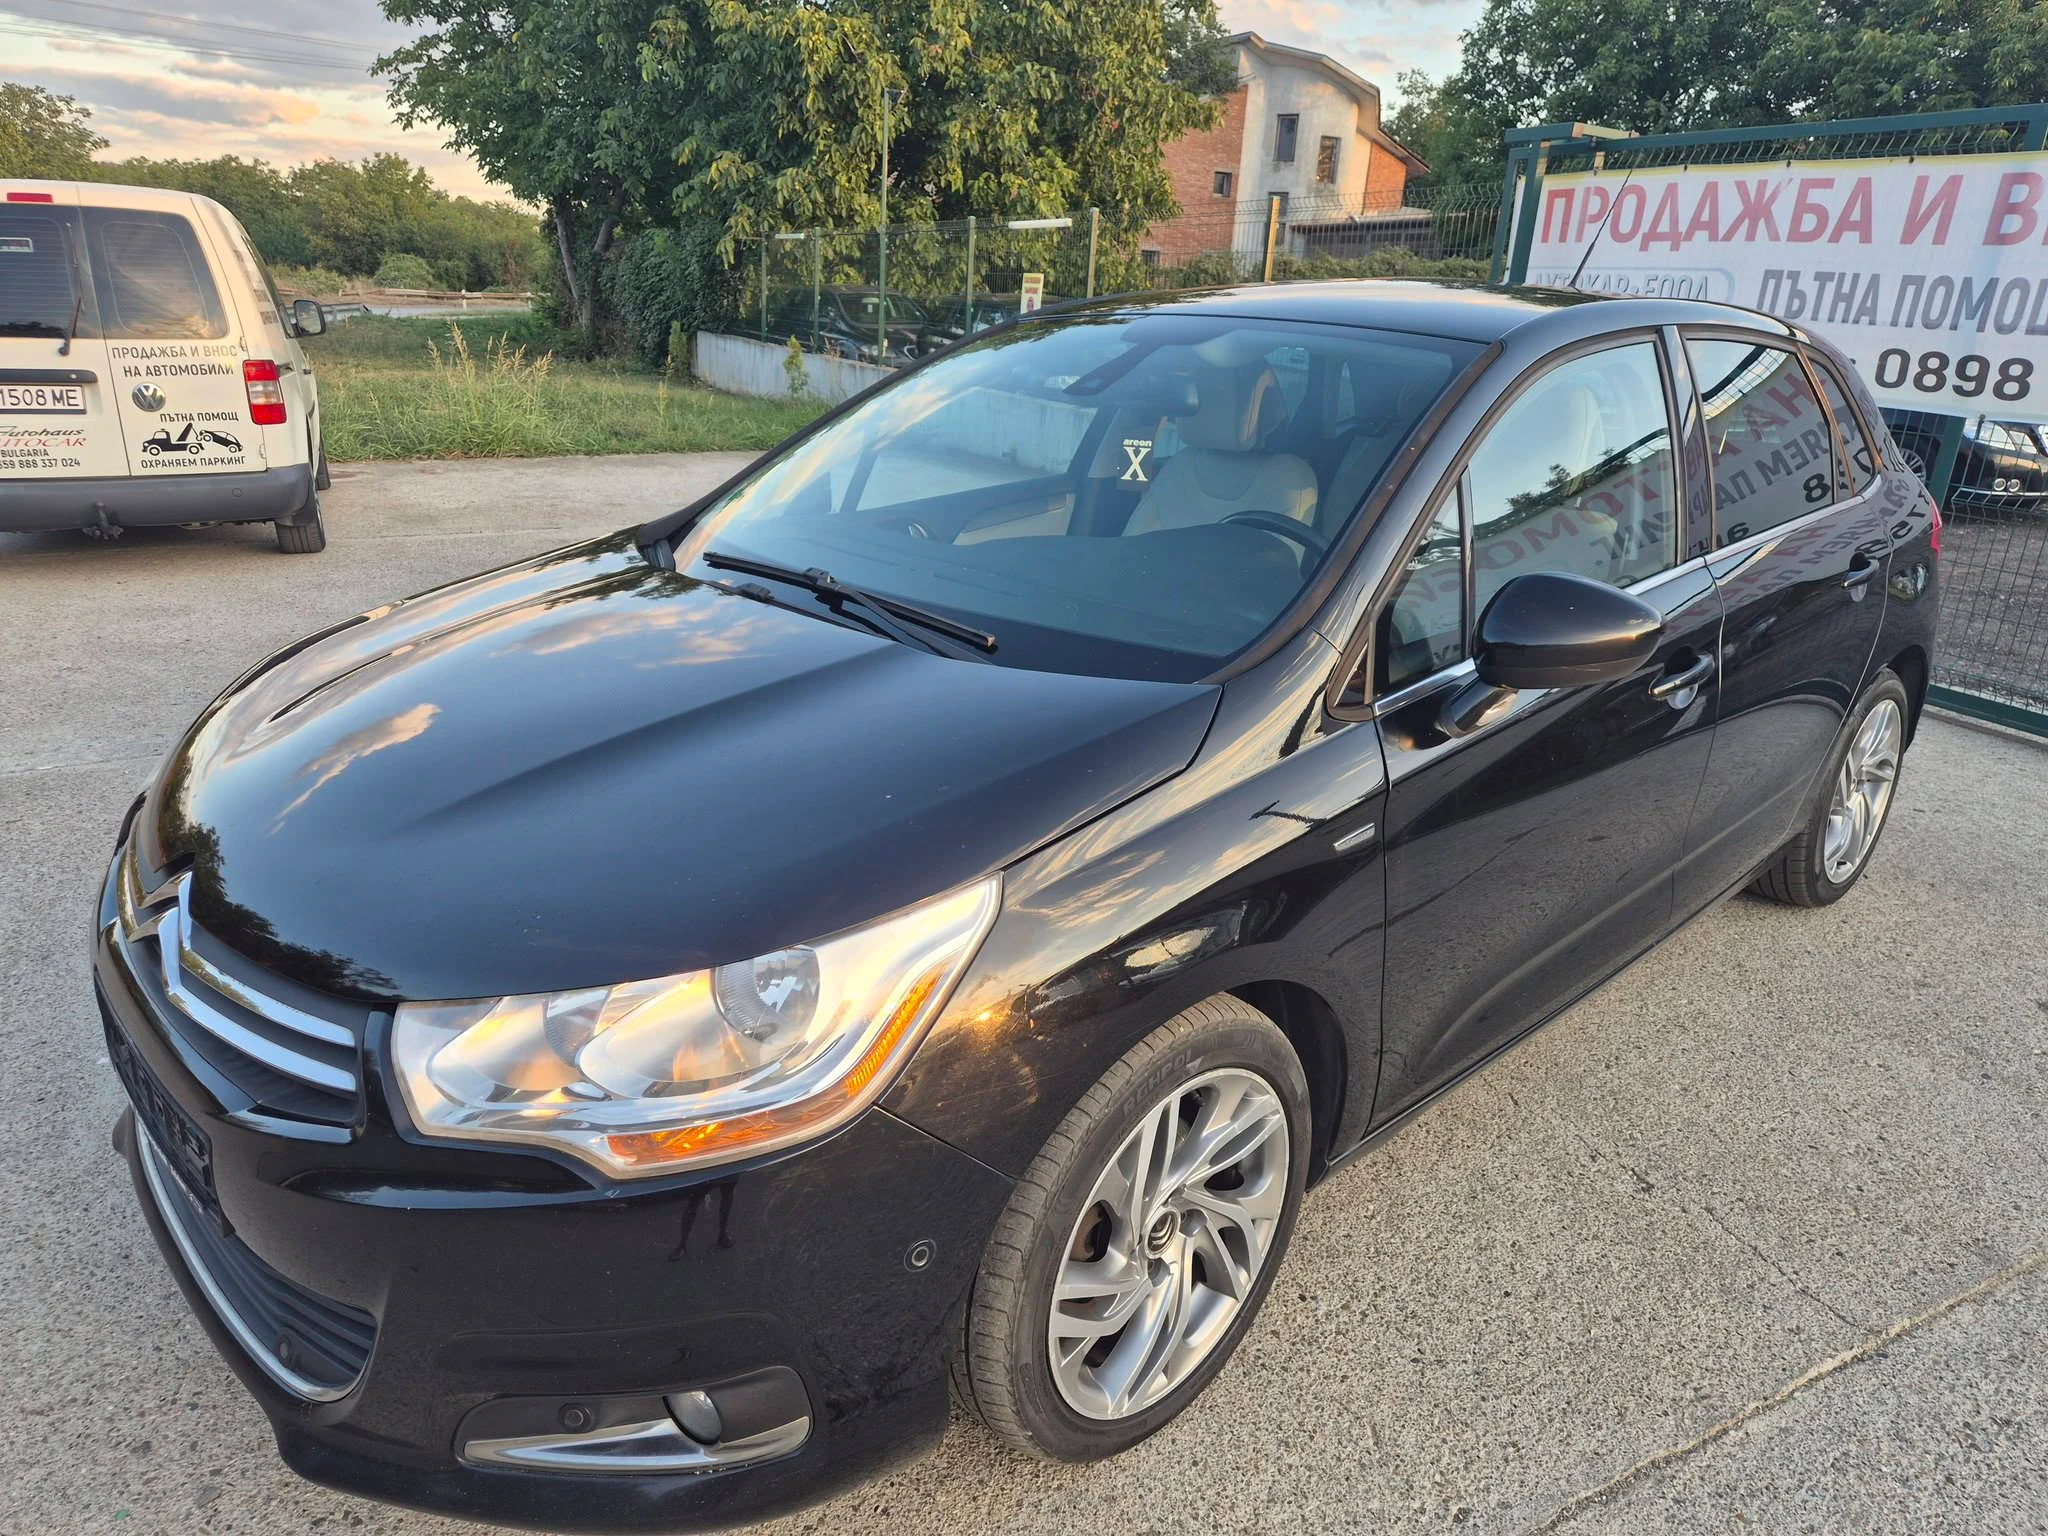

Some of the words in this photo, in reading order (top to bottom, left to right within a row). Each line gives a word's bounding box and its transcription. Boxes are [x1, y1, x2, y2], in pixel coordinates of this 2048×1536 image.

[1540, 176, 1873, 252] ПРОДАЖБА
[1900, 174, 1965, 246] И
[1982, 171, 2048, 246] В
[1756, 268, 1881, 326] ПЪТНА
[111, 345, 188, 360] ПРОДАЖБА
[190, 346, 201, 358] И
[203, 345, 238, 358] ВНОС
[123, 365, 142, 378] НА
[145, 363, 235, 378] АВТОМОБИЛИ
[1874, 347, 2035, 402] 0898
[51, 388, 81, 407] ME
[159, 413, 195, 423] ПЪТНА
[197, 411, 239, 422] ПОМОЩ
[1122, 438, 1153, 447] areon
[0, 448, 49, 458] BULGARIA
[18, 459, 38, 469] 888
[40, 458, 58, 468] 337
[61, 457, 81, 467] 024
[141, 458, 198, 469] ОХРАНЯЕМ
[200, 456, 245, 466] ПАРКИНГ
[1120, 446, 1152, 482] X
